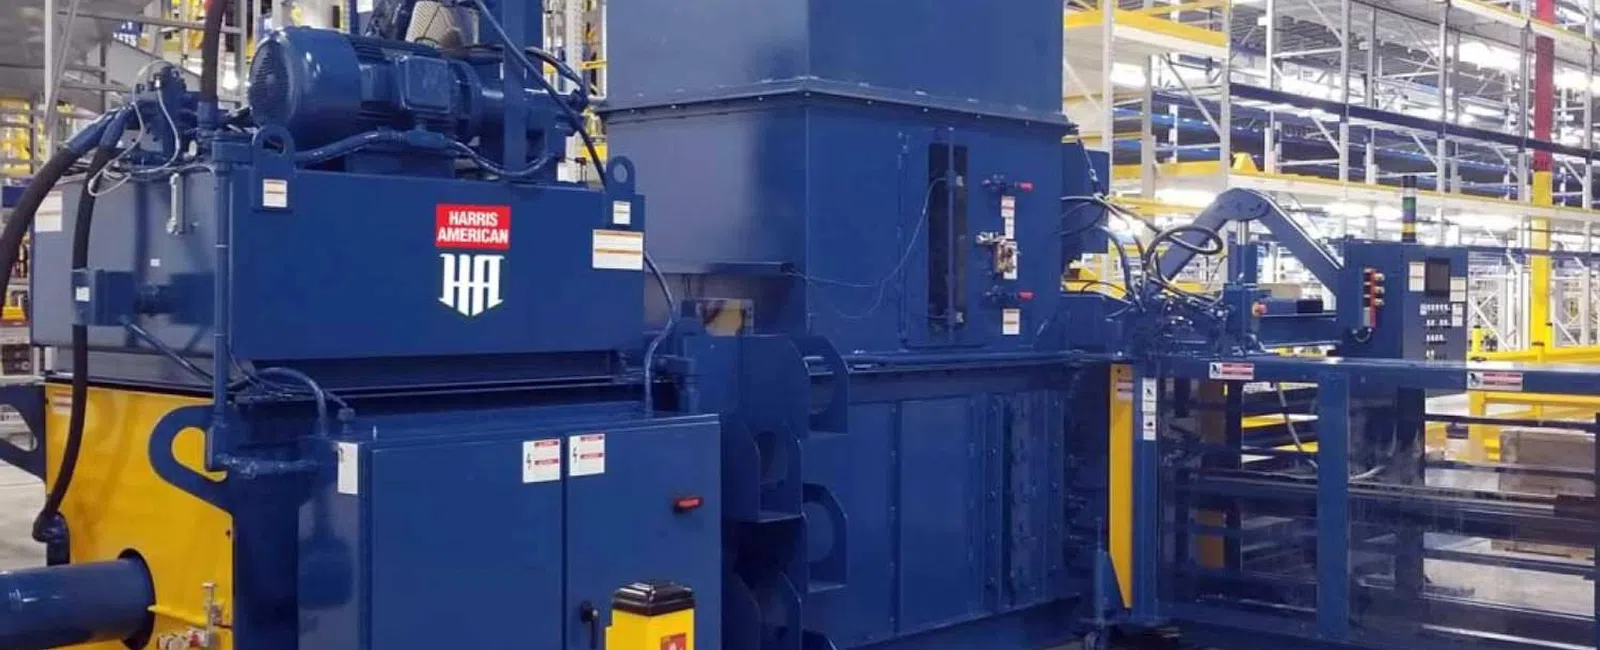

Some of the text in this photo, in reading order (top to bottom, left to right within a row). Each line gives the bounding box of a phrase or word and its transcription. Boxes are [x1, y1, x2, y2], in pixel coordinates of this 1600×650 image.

[448, 211, 499, 226] HARRIS
[437, 226, 509, 244] AMERICAN
[438, 253, 504, 316] HA
